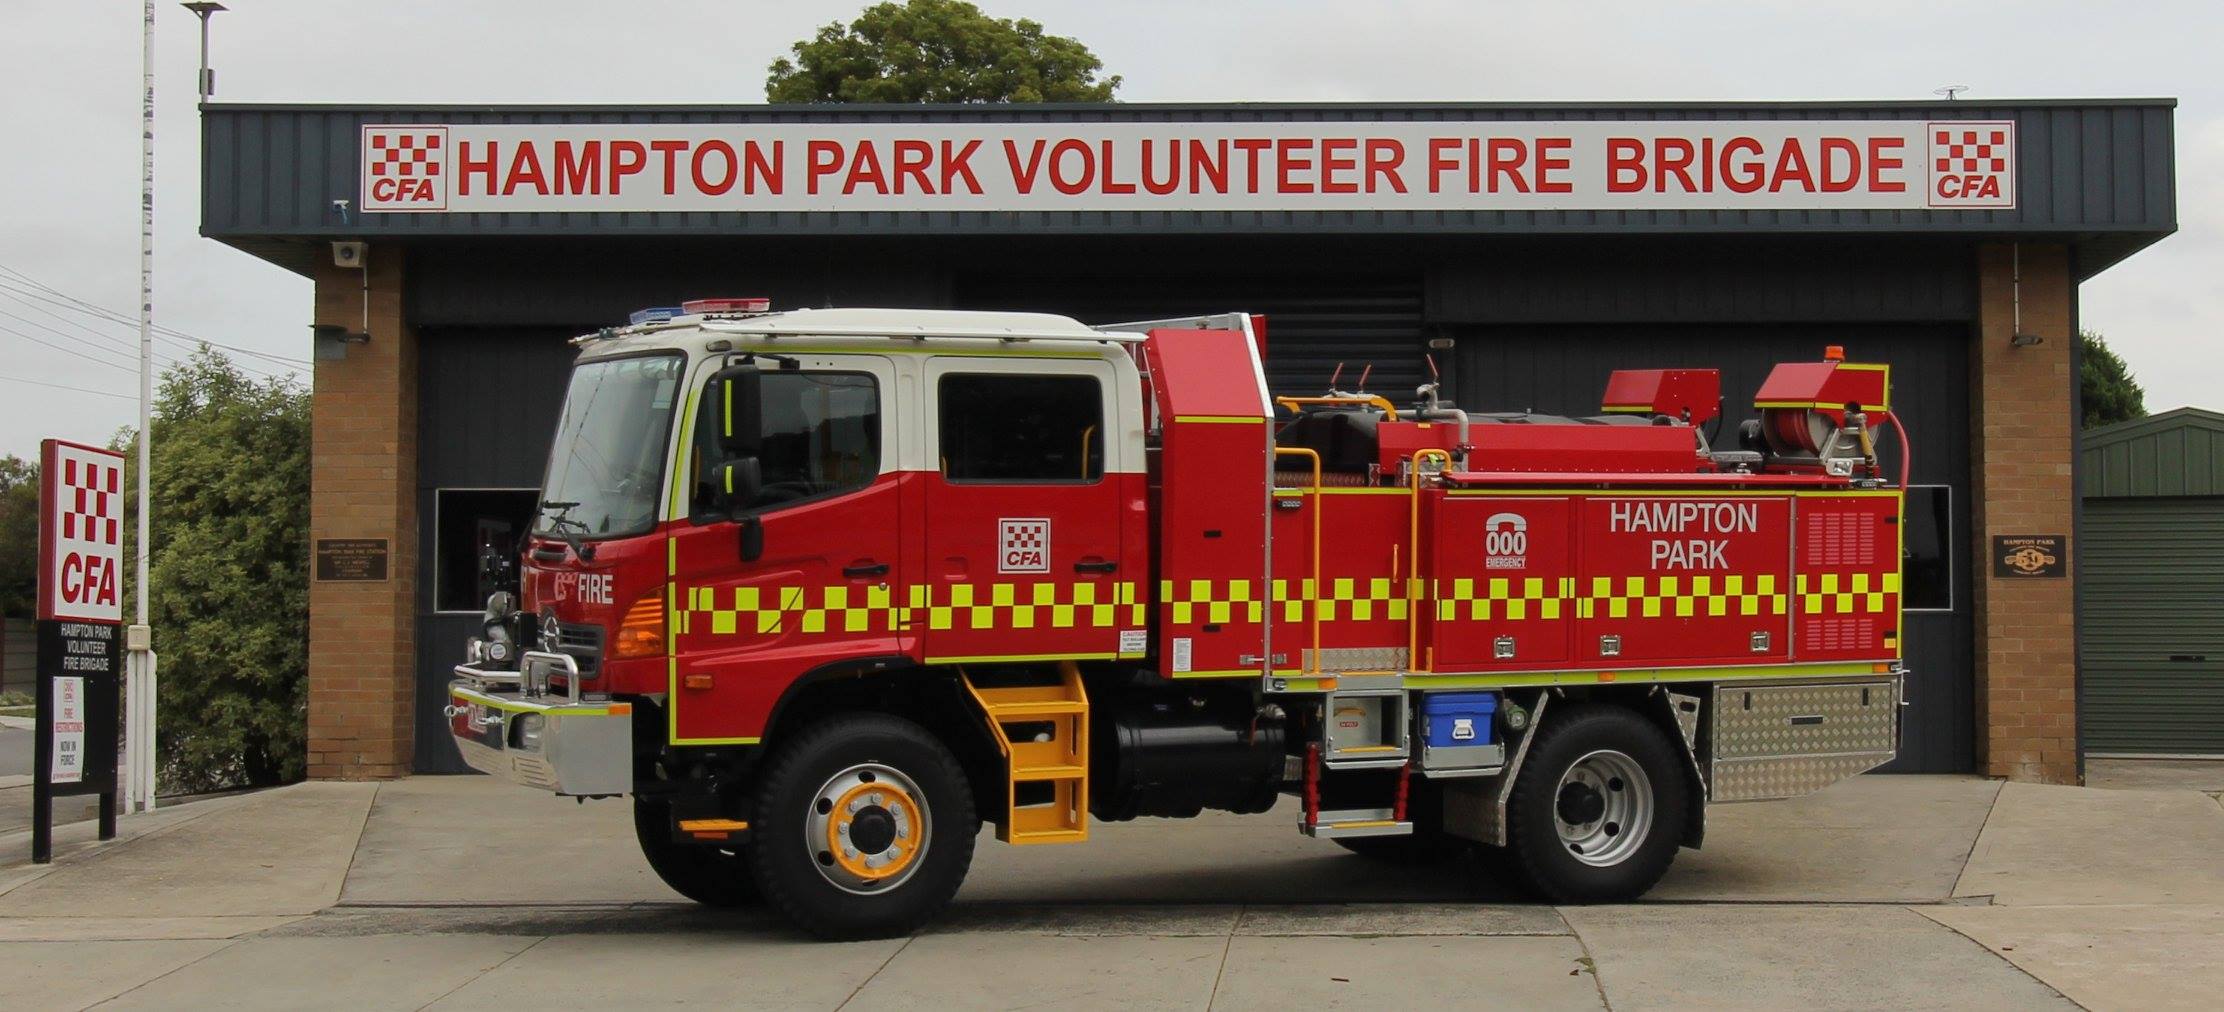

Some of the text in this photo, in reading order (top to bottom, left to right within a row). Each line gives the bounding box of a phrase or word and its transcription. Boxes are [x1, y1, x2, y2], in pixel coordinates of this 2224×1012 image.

[458, 136, 1906, 196] HAMPTON PARK VOLUNTEER FIRE BRIGADE
[372, 178, 435, 202] CFA
[1936, 174, 2002, 199] CFA
[1610, 502, 1758, 533] HAMPTON
[1485, 531, 1527, 556] 000
[1650, 539, 1729, 570] PARK
[1006, 551, 1042, 566] CFA
[1485, 556, 1526, 569] EMERGENCY
[61, 552, 117, 606] CFA
[578, 573, 614, 605] FIRE
[61, 623, 113, 640] HAMPTON PARK
[67, 640, 107, 655] VOLUNTEER
[63, 656, 109, 671] FIRE BRIGADE
